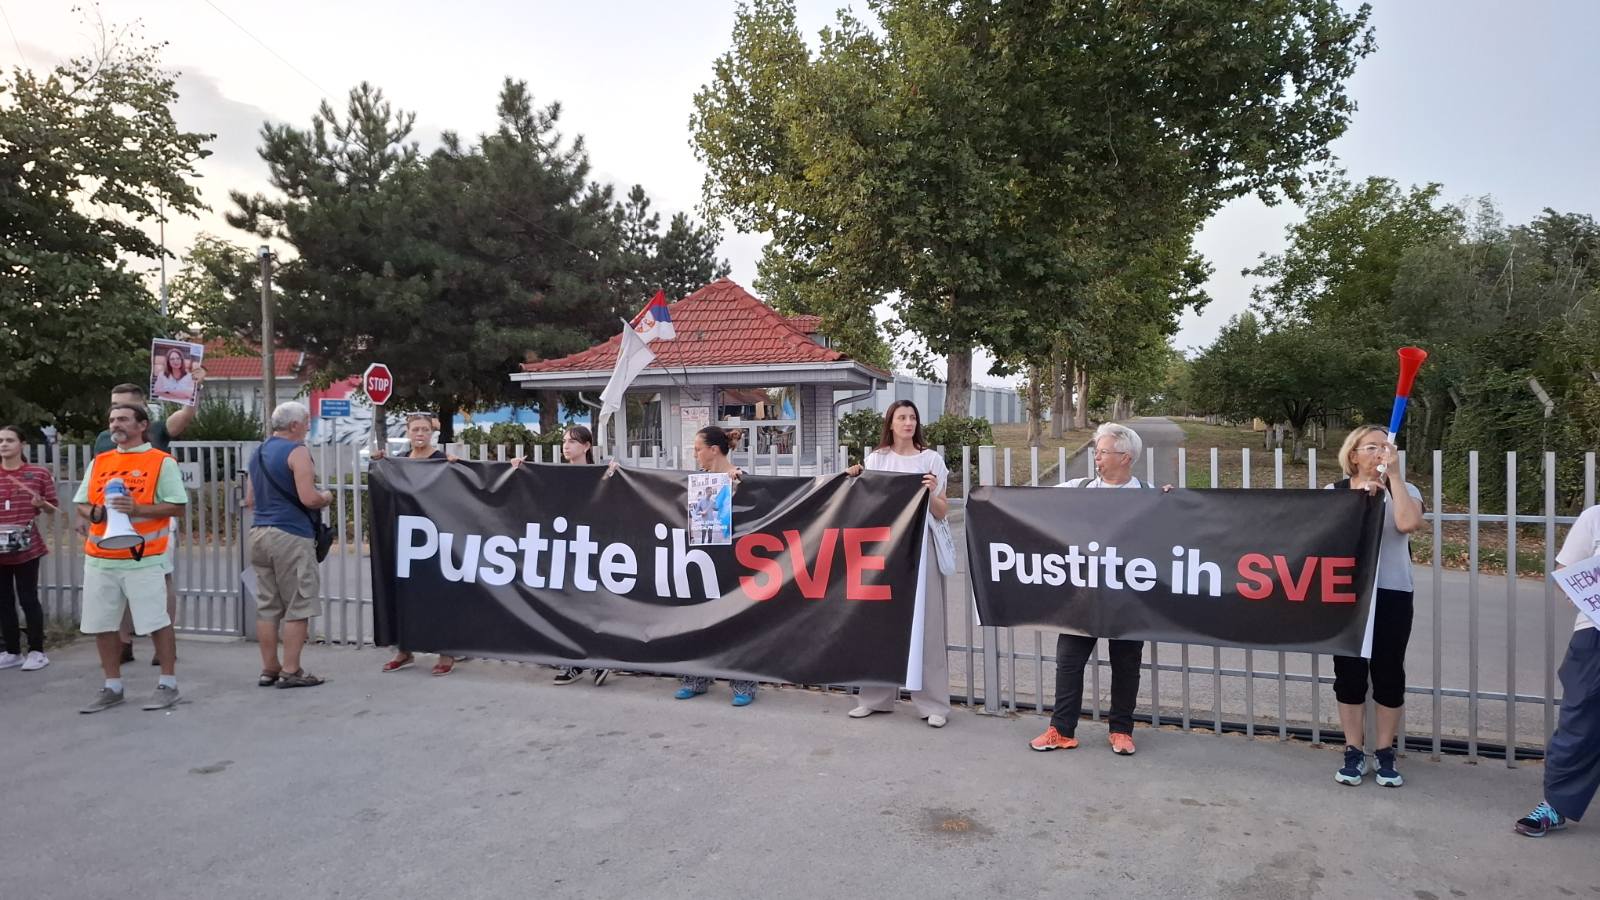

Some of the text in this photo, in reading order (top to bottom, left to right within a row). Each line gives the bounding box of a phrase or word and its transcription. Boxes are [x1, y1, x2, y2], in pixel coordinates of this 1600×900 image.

[368, 377, 389, 391] STOP
[396, 514, 892, 601] Pustite ih SVE
[989, 541, 1356, 603] Pustite ih SVE
